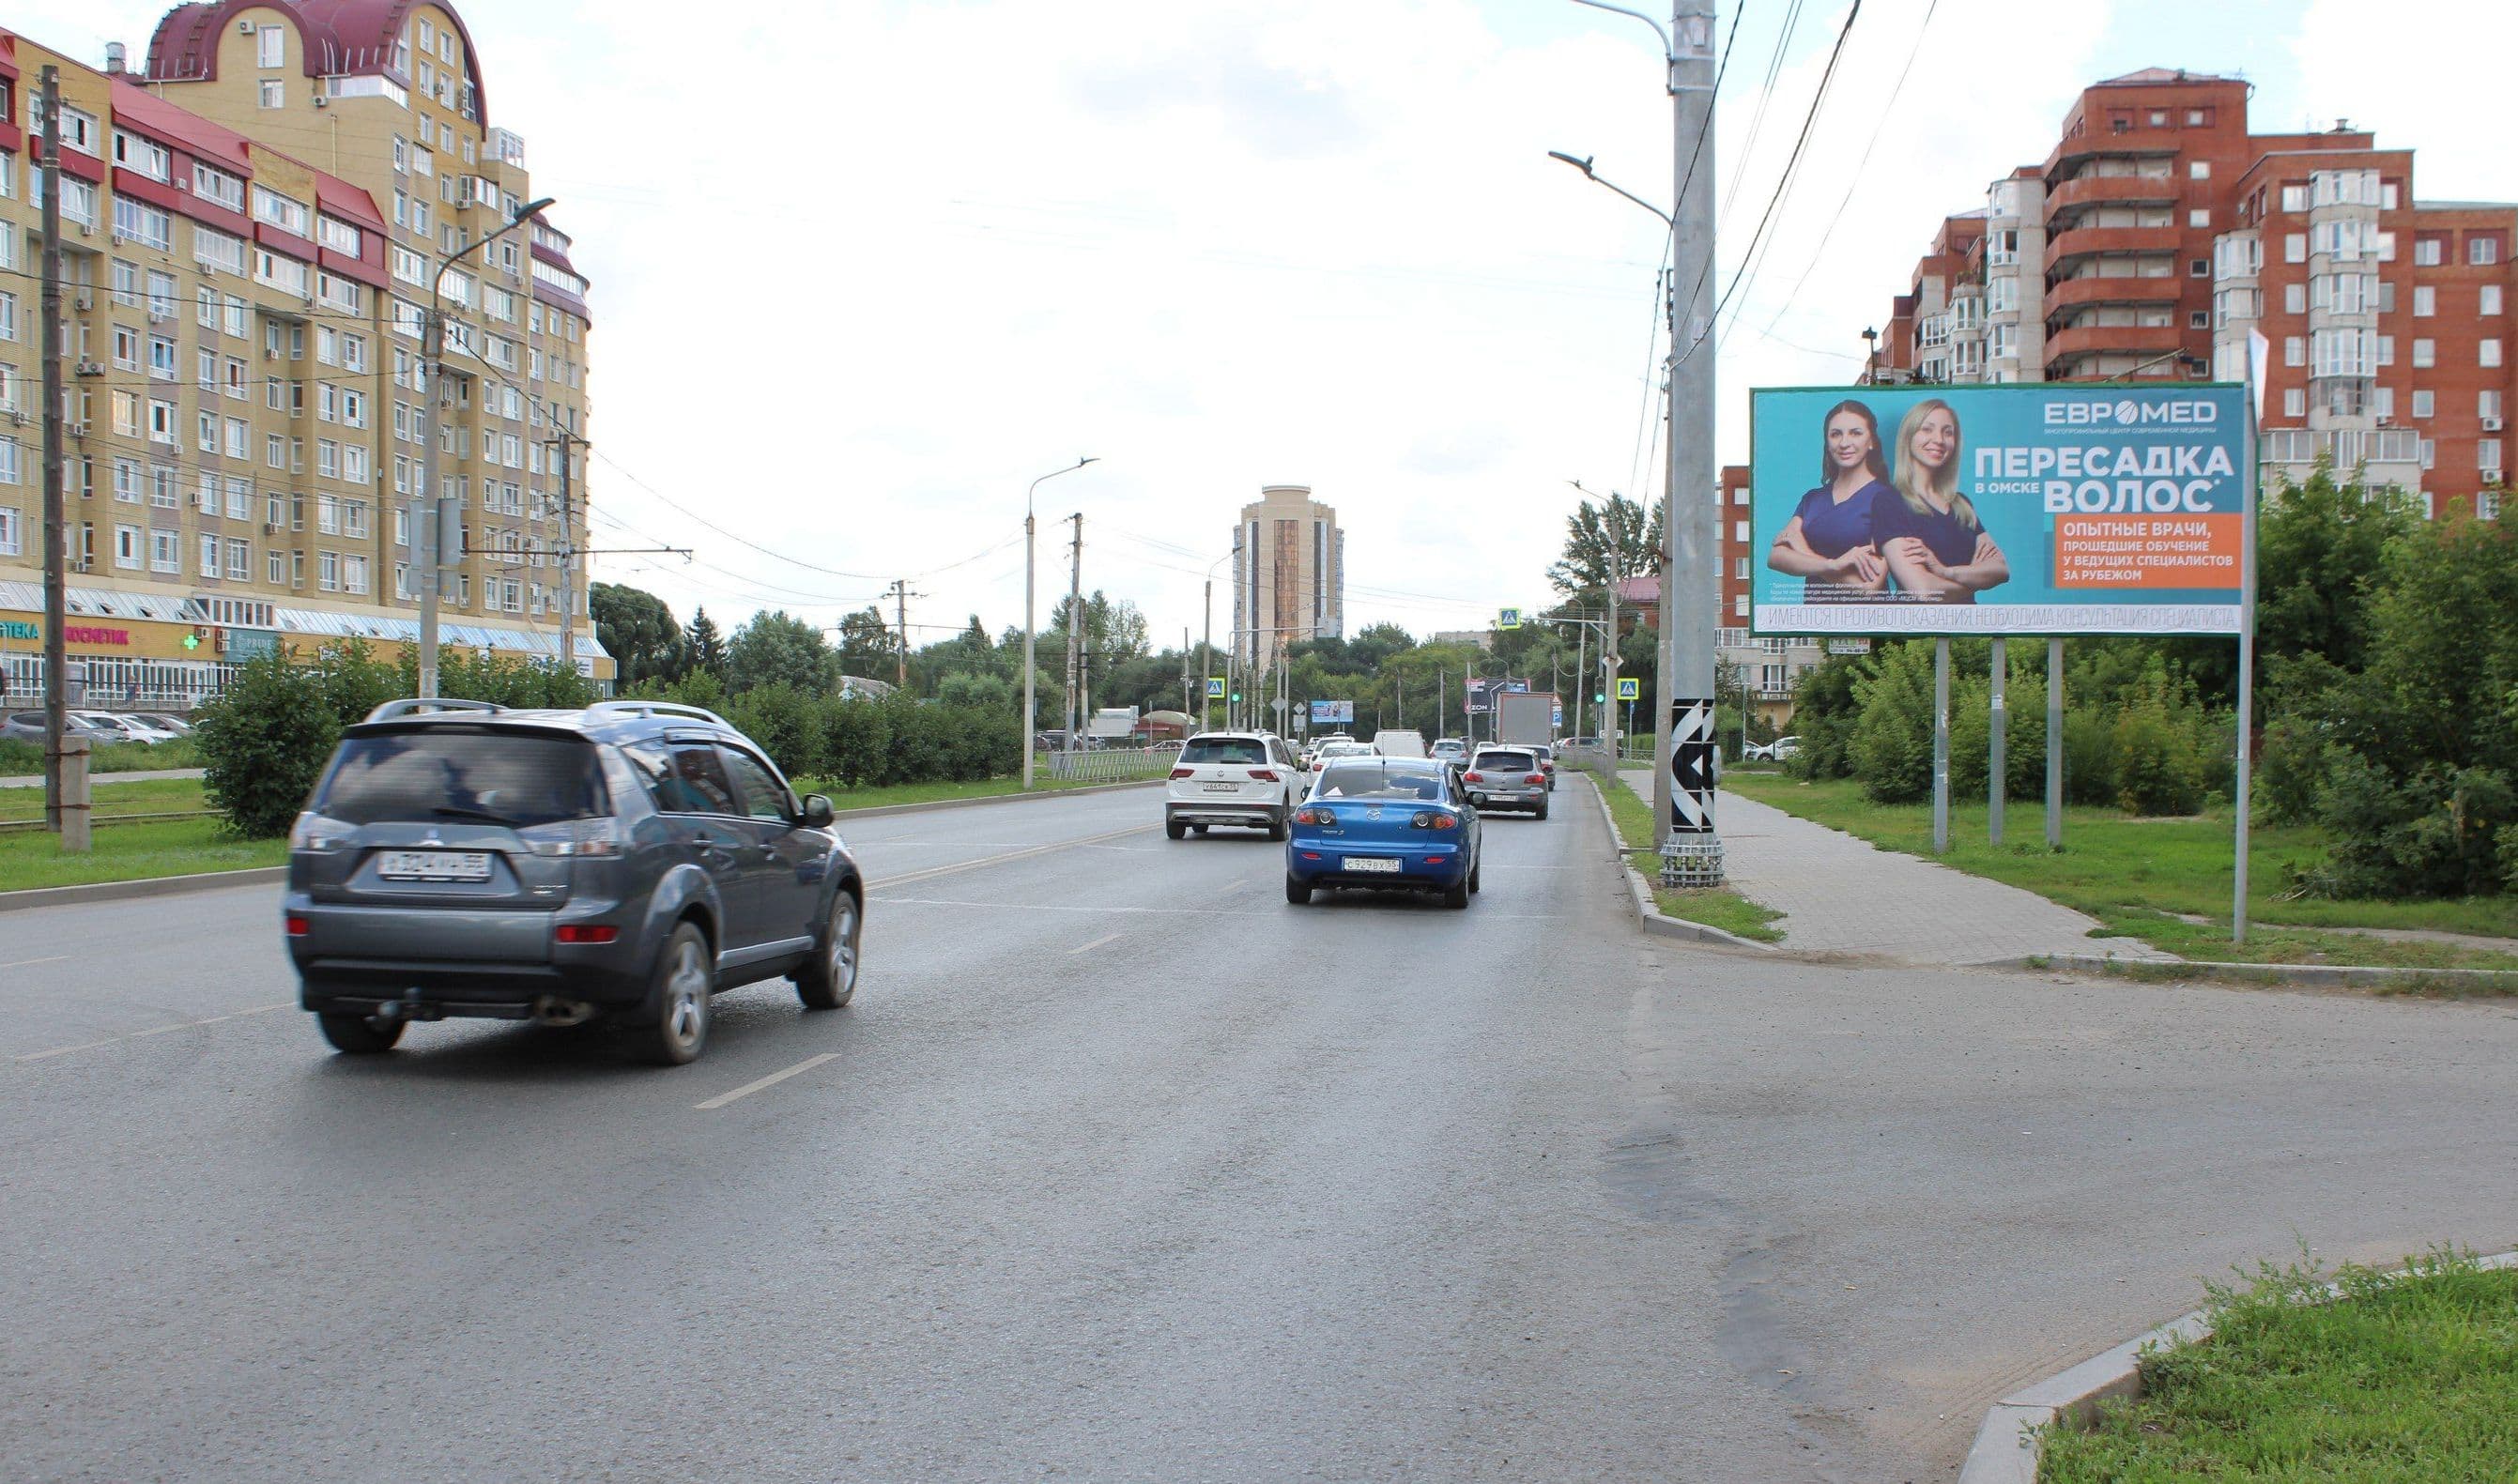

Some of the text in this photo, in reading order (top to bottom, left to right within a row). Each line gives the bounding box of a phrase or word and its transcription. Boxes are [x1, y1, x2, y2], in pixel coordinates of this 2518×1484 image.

[1974, 445, 2234, 478] ПЕРЕСАДКА
[1974, 482, 2040, 494] В ОМСКЕ
[2063, 522, 2212, 539] ОПЫТНЫЕ ВРАЧИ,
[2063, 541, 2209, 553] ПРОШЕДШИЕ ОБУЧЕНИЕ
[2063, 556, 2234, 568] У ВЕДУЩИХ СПЕЦИАЛИСТОВ
[2063, 570, 2142, 581] ЗА РУБЕЖОМ
[1768, 607, 1830, 626] ИМЕЮТСЯ
[1975, 607, 2053, 626] НЕОБХОДИМА
[2057, 607, 2147, 626] КОНСУЛЬТАЦИЯ
[2151, 607, 2234, 626] СПЕЦИАЛИСТА
